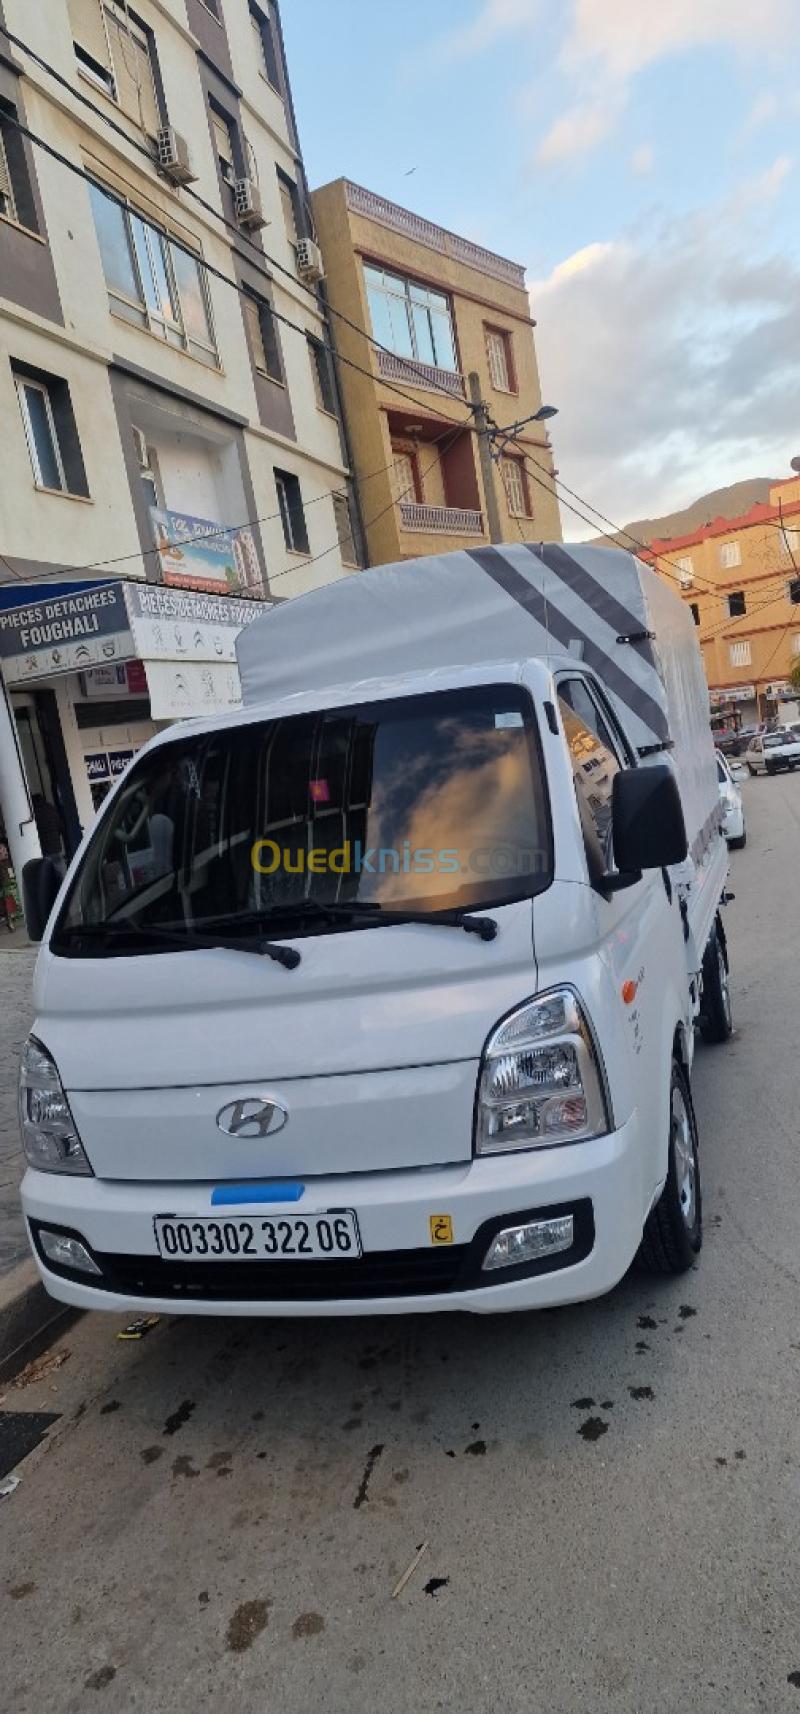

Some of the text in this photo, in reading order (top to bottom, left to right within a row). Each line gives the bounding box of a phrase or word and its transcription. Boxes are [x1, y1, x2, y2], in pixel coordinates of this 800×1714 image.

[0, 590, 117, 630] PIECES DETACHEES
[139, 591, 177, 615] PIECES
[178, 597, 229, 620] DETACHEES
[20, 613, 100, 648] FOUGHALI
[162, 1218, 351, 1254] 003302 322 06
